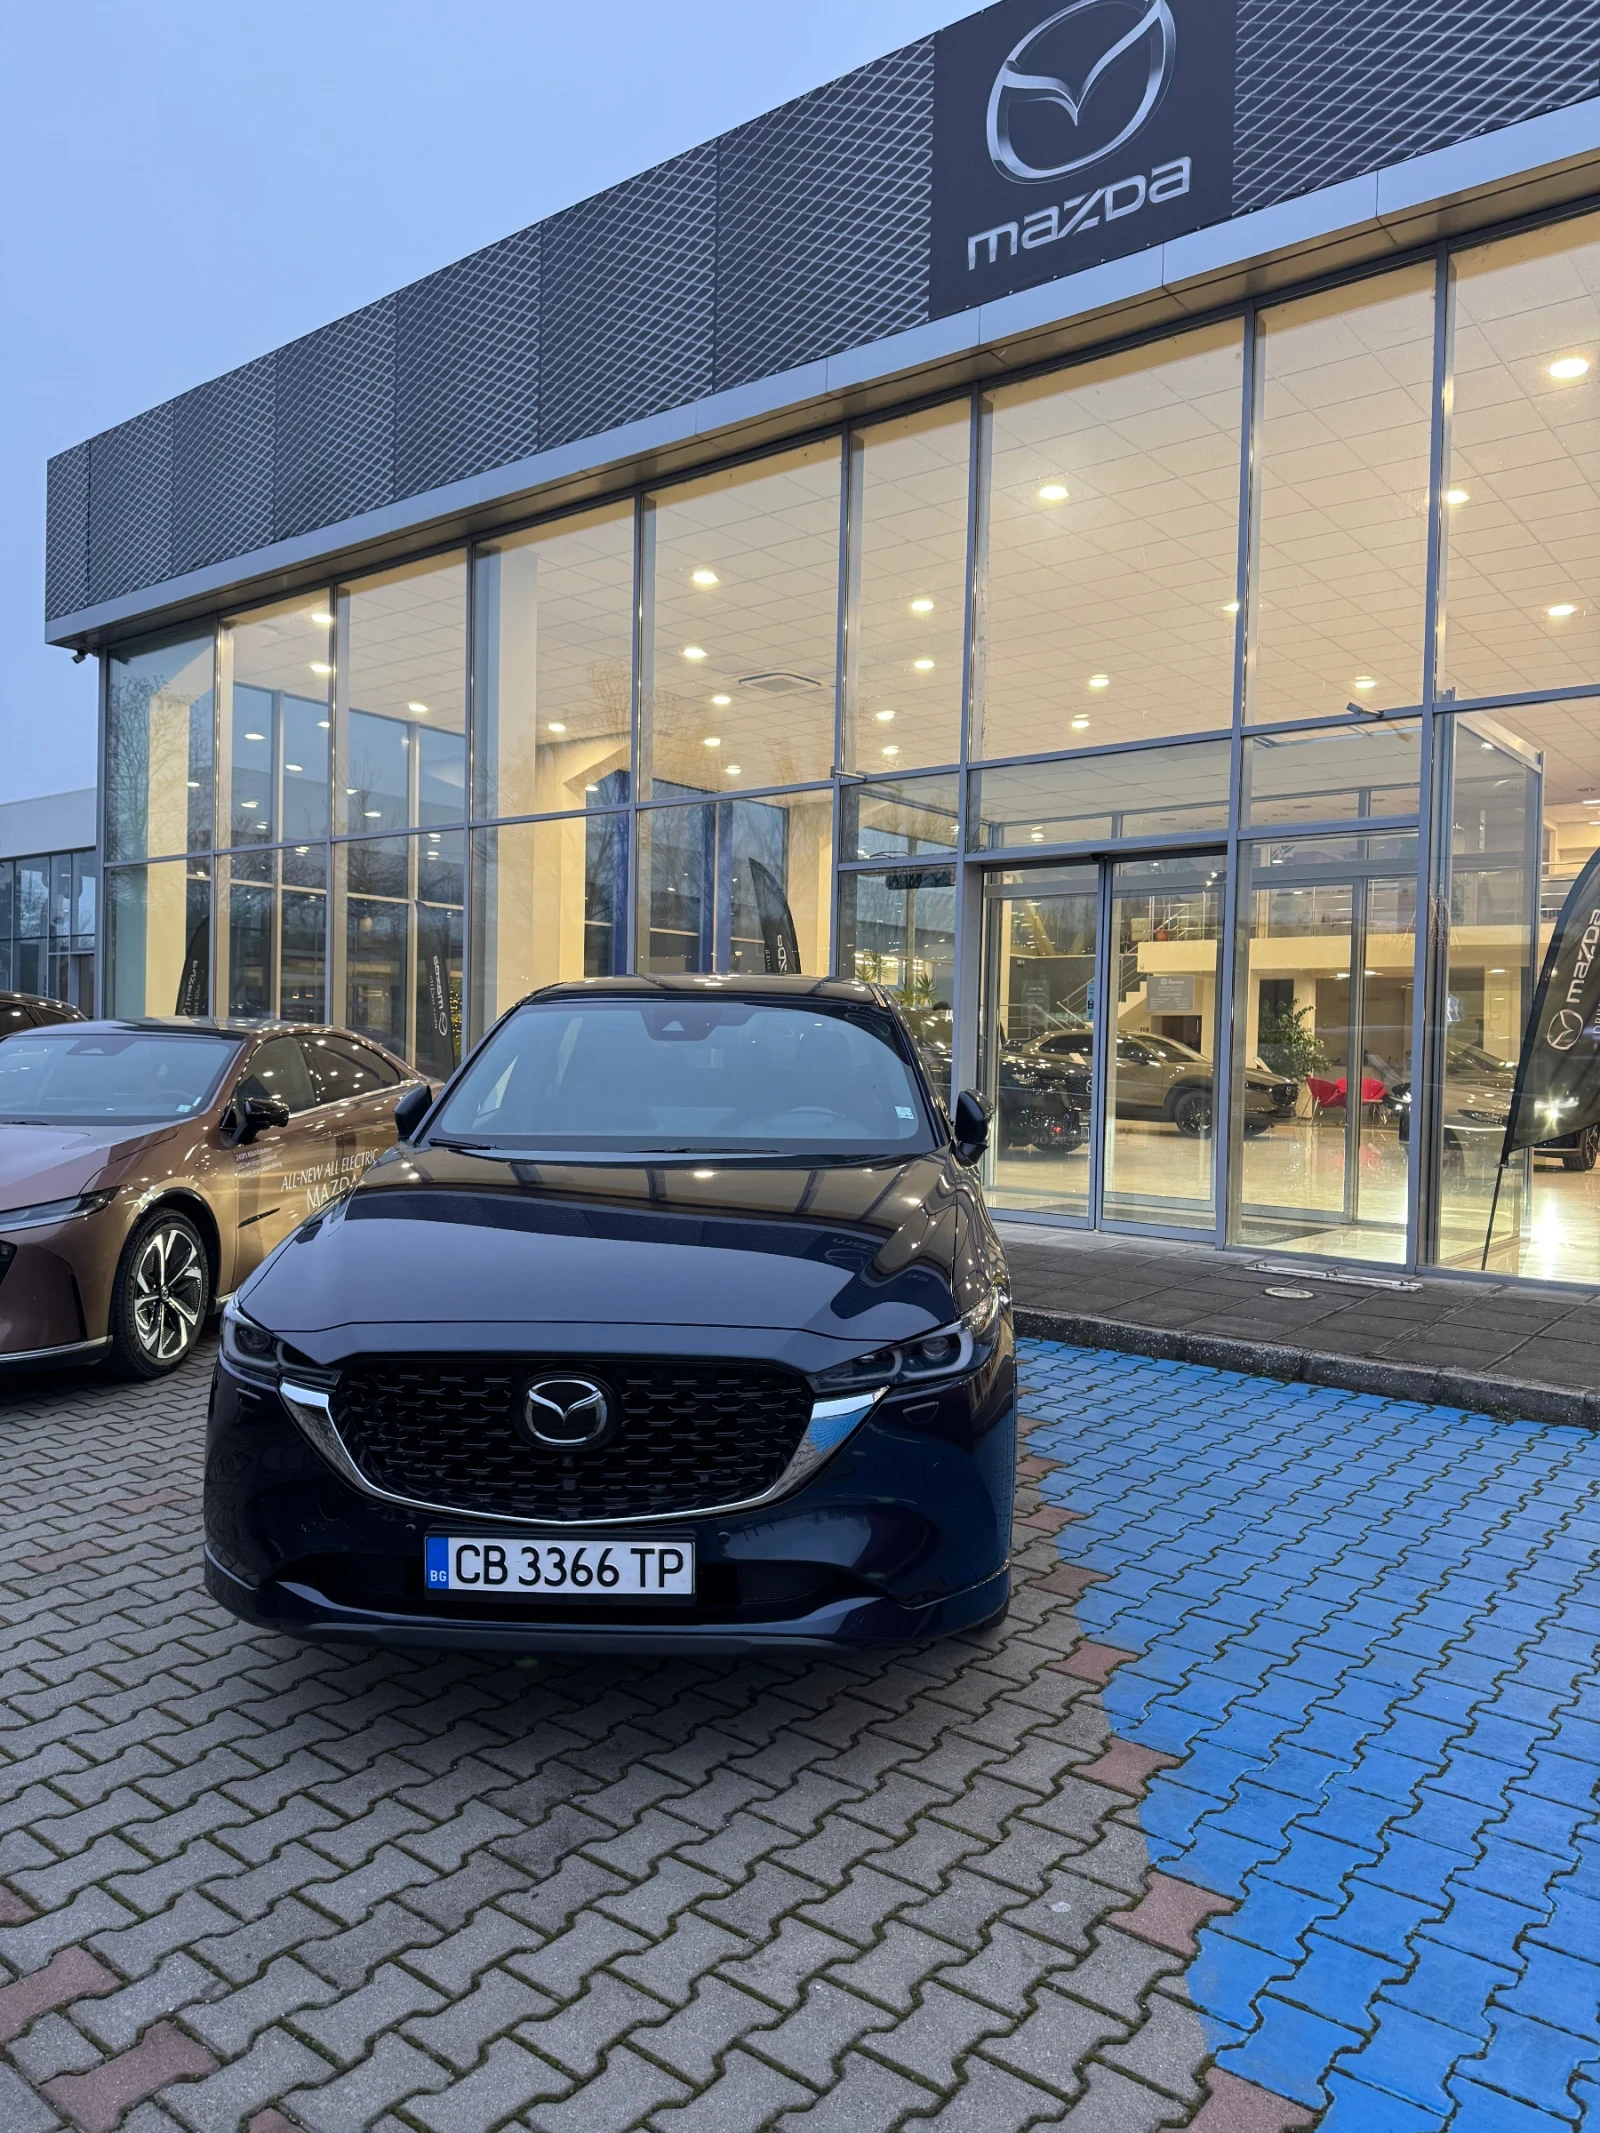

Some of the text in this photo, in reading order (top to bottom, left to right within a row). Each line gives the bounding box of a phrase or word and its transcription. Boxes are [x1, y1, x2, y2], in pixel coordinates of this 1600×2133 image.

[280, 1163, 324, 1193] ALL-NEW
[323, 1160, 339, 1178] ALL
[341, 1148, 379, 1173] ELECTRIC
[430, 1570, 447, 1582] BG
[455, 1545, 684, 1588] CB 3366 TP
